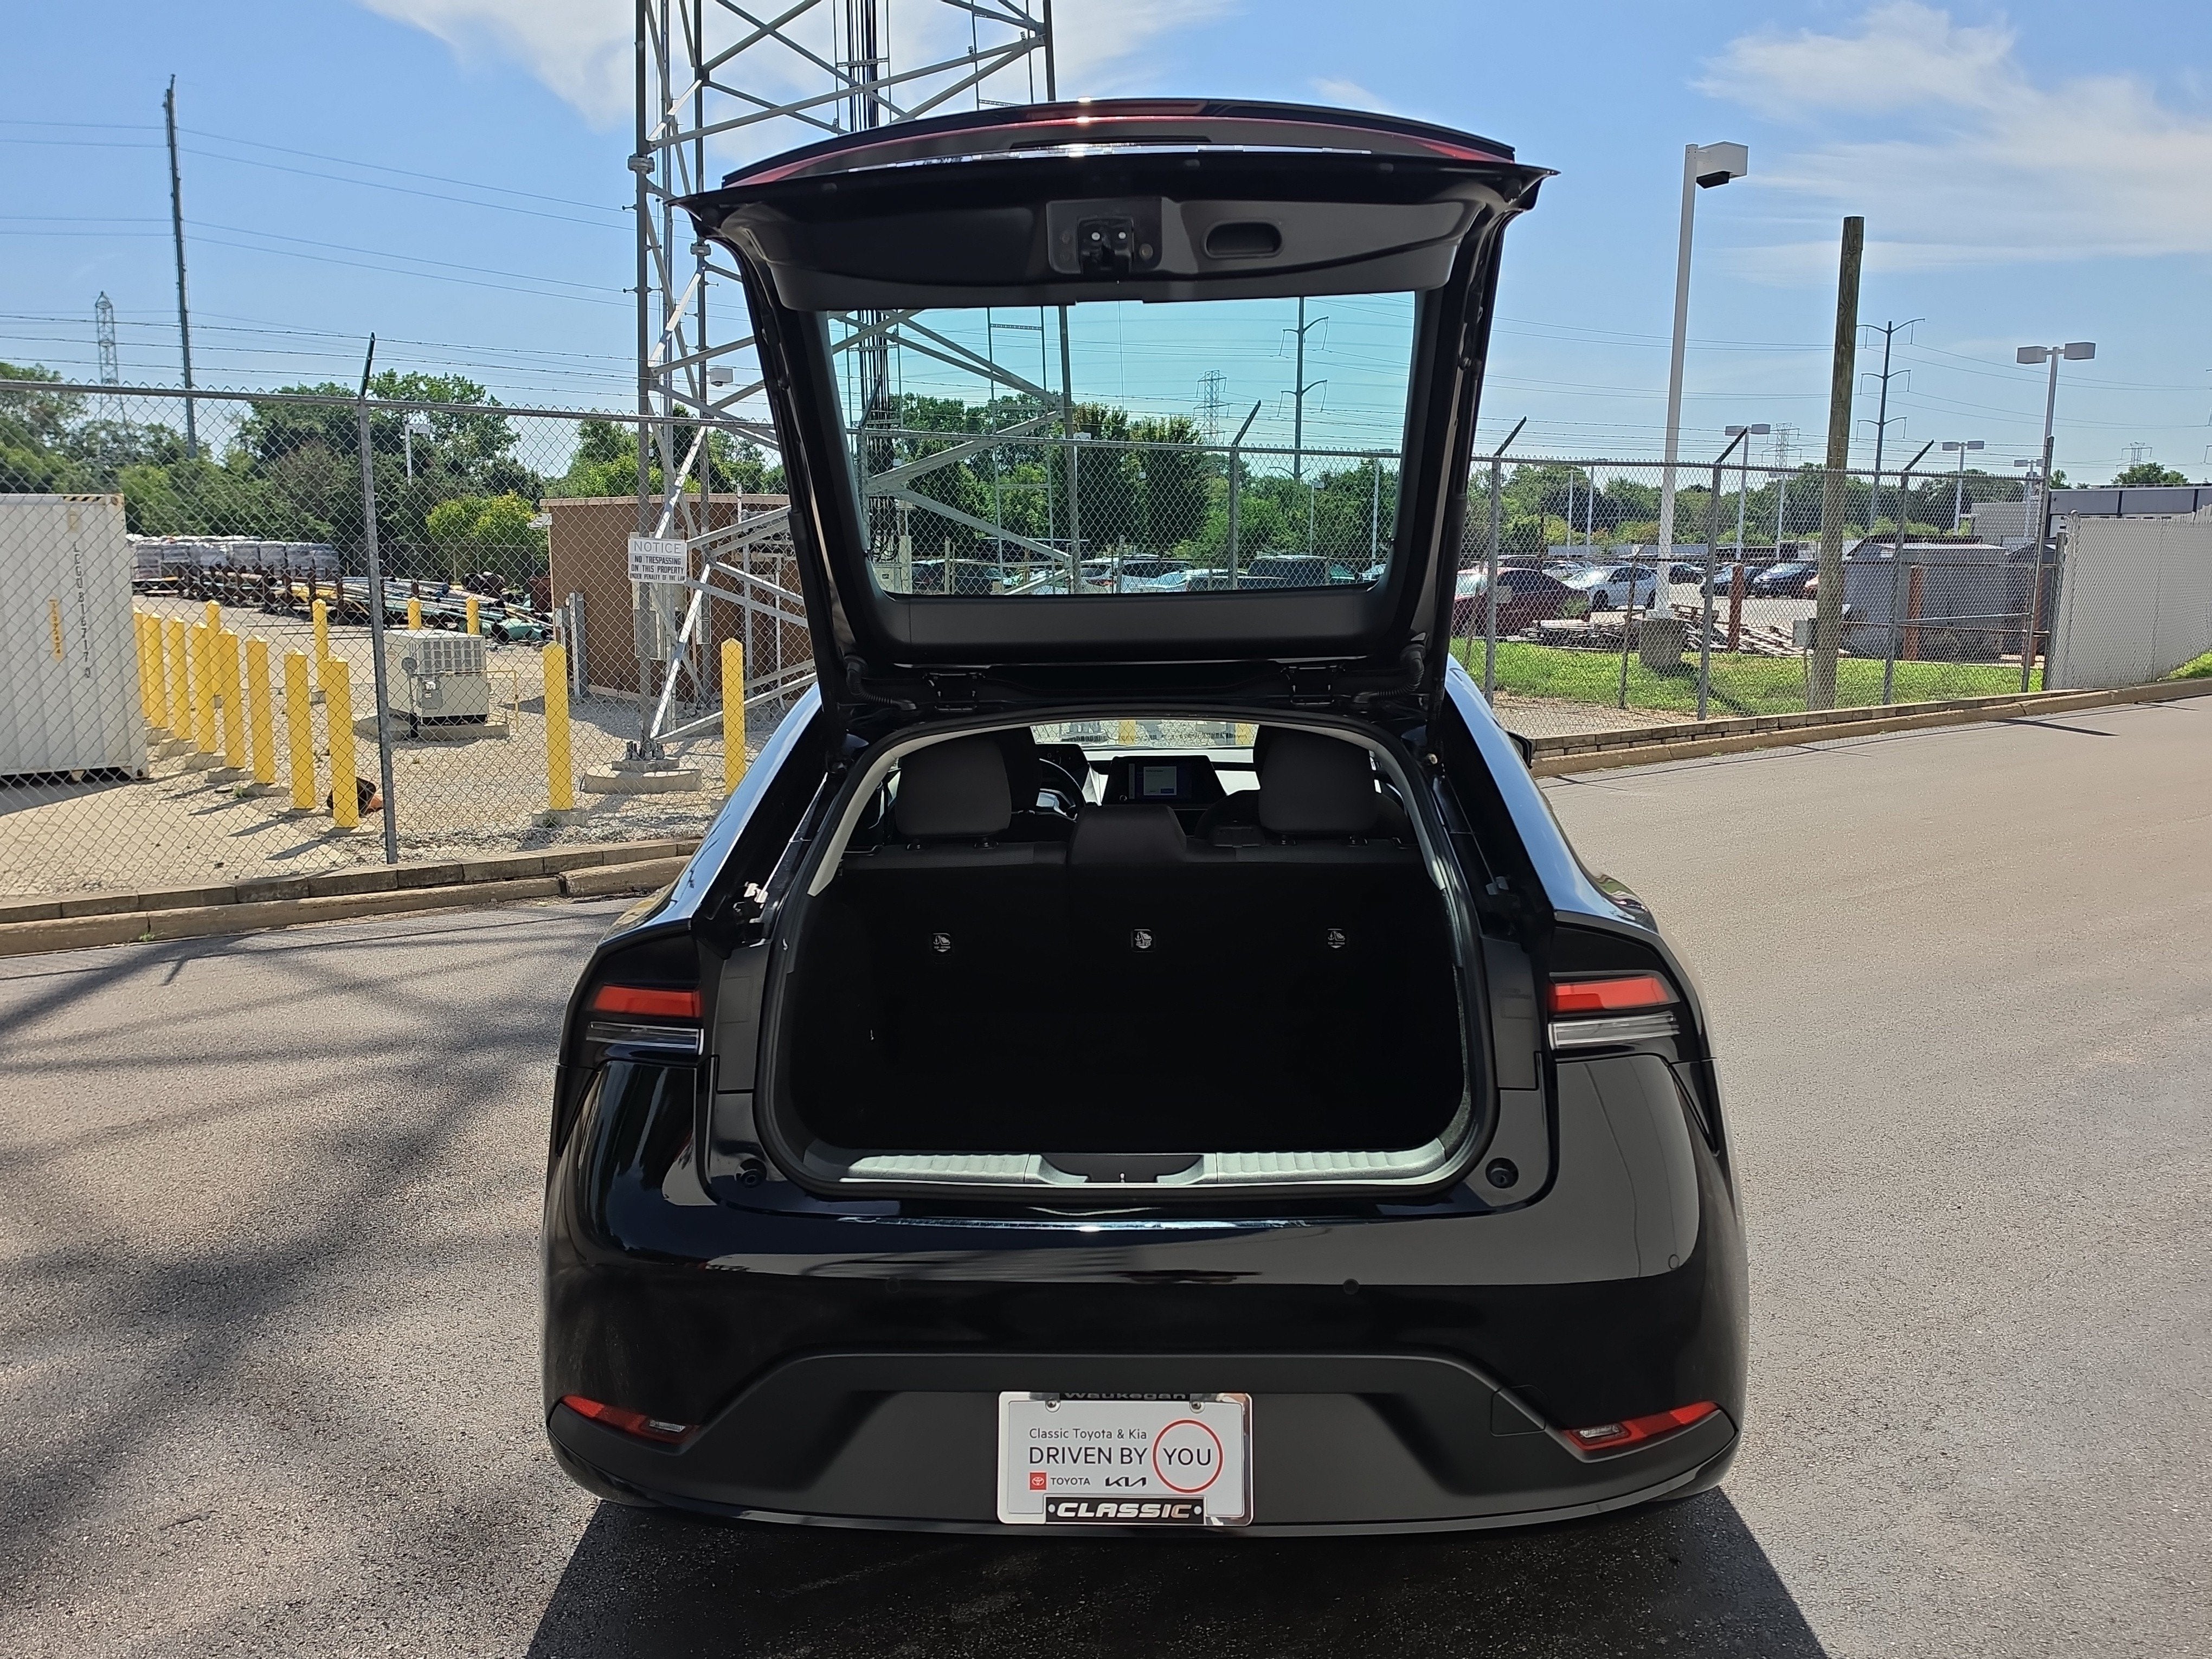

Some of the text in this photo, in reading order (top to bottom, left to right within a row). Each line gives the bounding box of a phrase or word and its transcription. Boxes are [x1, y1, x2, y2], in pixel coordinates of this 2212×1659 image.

[634, 541, 681, 554] NOTICE
[634, 555, 681, 565] NO TRESPASSING
[631, 564, 685, 575] ON THIS PROPERTY
[1029, 1427, 1147, 1441] Classic Toyota & Kia
[1030, 1446, 1212, 1466] DRIVEN BY YOU
[1051, 1477, 1091, 1486] TOYOTA
[1056, 1502, 1192, 1519] CLASSIC
